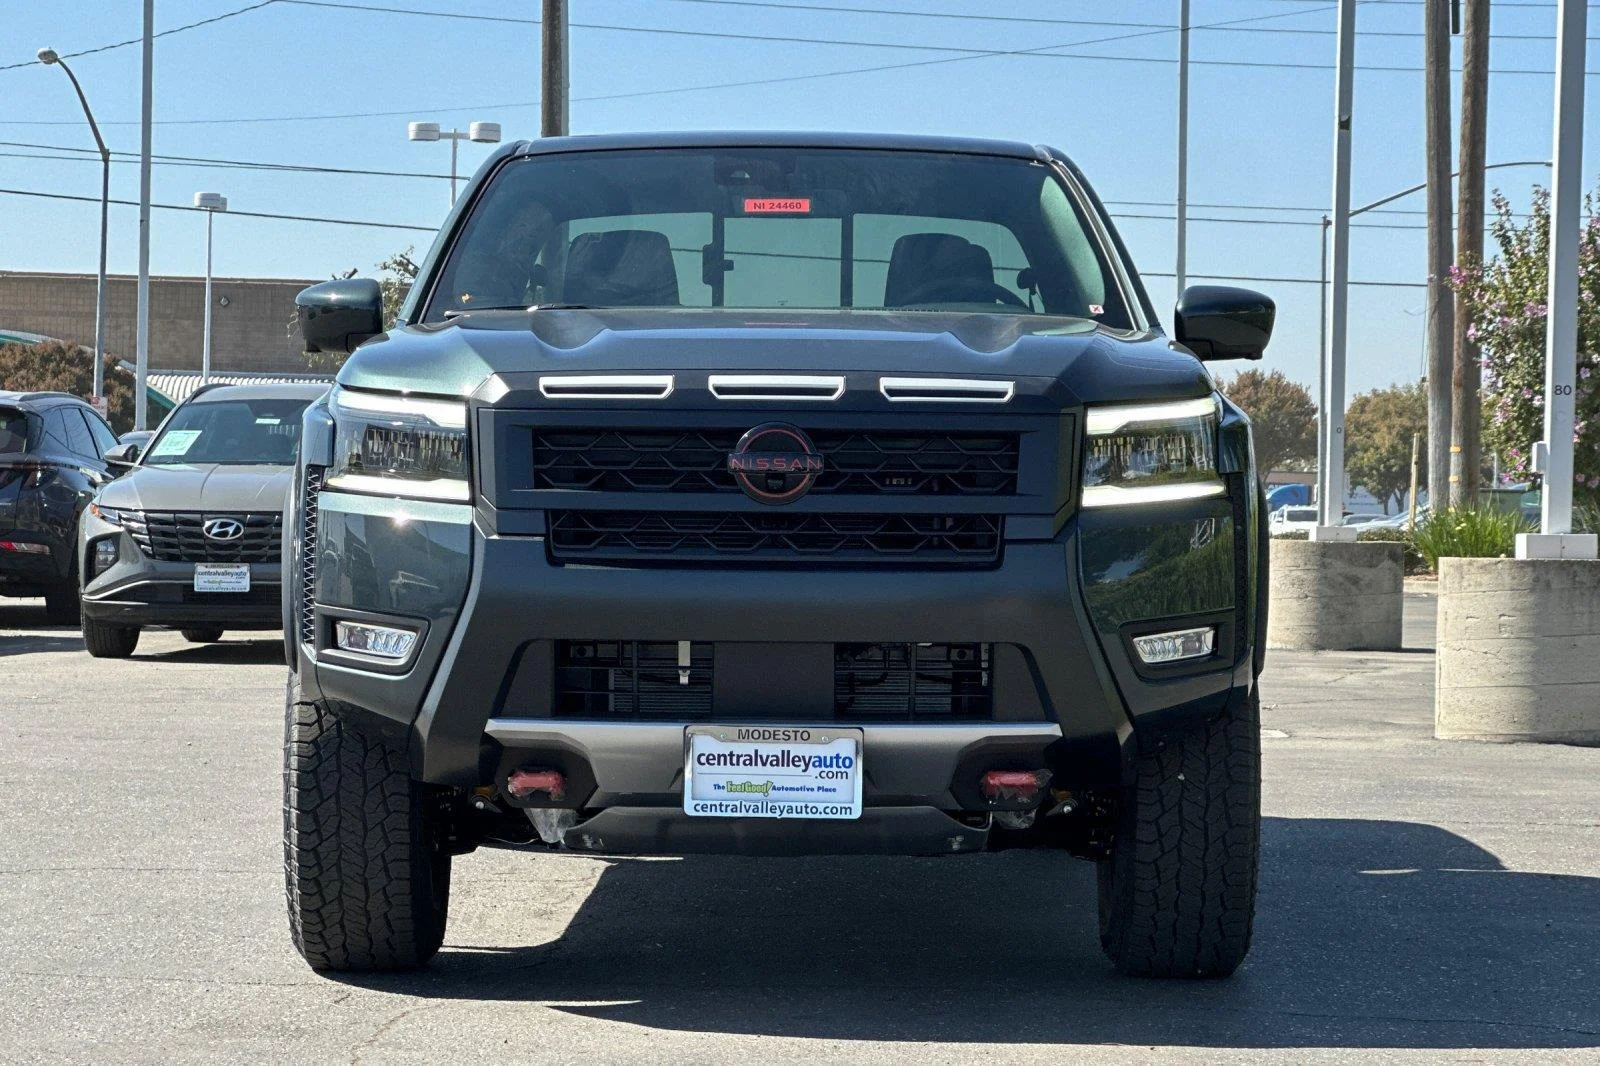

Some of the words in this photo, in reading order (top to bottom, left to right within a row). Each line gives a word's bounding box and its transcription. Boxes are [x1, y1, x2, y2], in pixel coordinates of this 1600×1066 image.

[753, 202, 765, 210] NI
[768, 202, 802, 210] 24460
[1554, 384, 1572, 396] 80
[731, 458, 821, 471] NISSAN
[737, 729, 811, 742] MODESTO
[696, 749, 853, 773] centralvalleyauto
[814, 769, 849, 780] .com
[713, 783, 726, 791] The
[771, 784, 815, 793] Automotive
[816, 785, 837, 793] Place
[693, 801, 853, 816] centralvalleyauto.com
